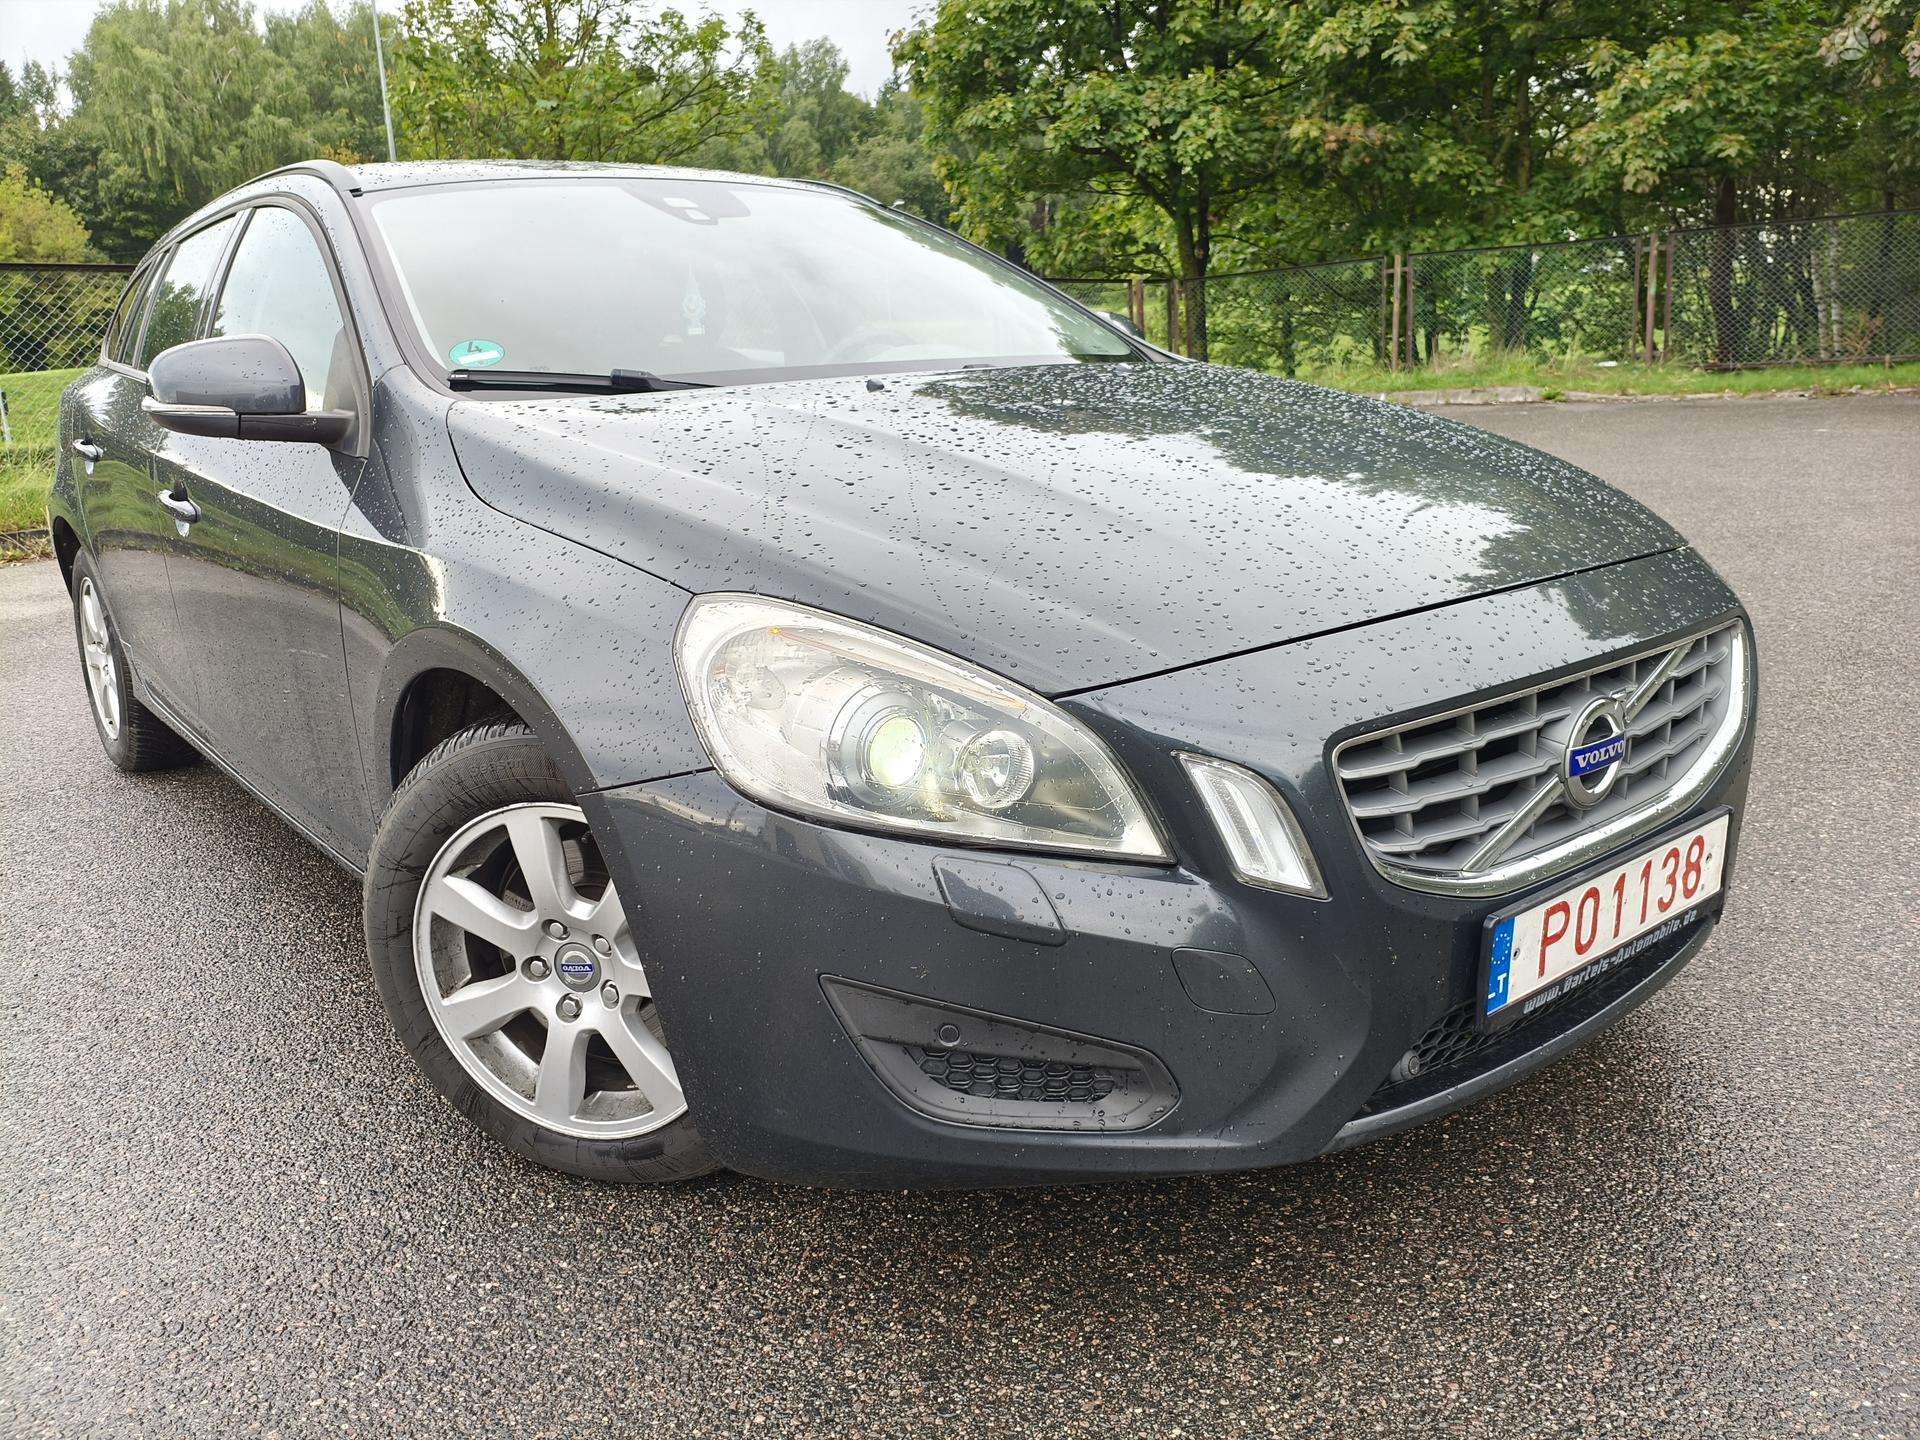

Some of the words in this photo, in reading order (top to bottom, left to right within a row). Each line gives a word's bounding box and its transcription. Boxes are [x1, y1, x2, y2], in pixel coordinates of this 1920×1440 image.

[1575, 740, 1625, 768] VOLVO
[1538, 834, 1705, 979] P01138
[1523, 909, 1697, 1014] www.Bartels-Automobile.de
